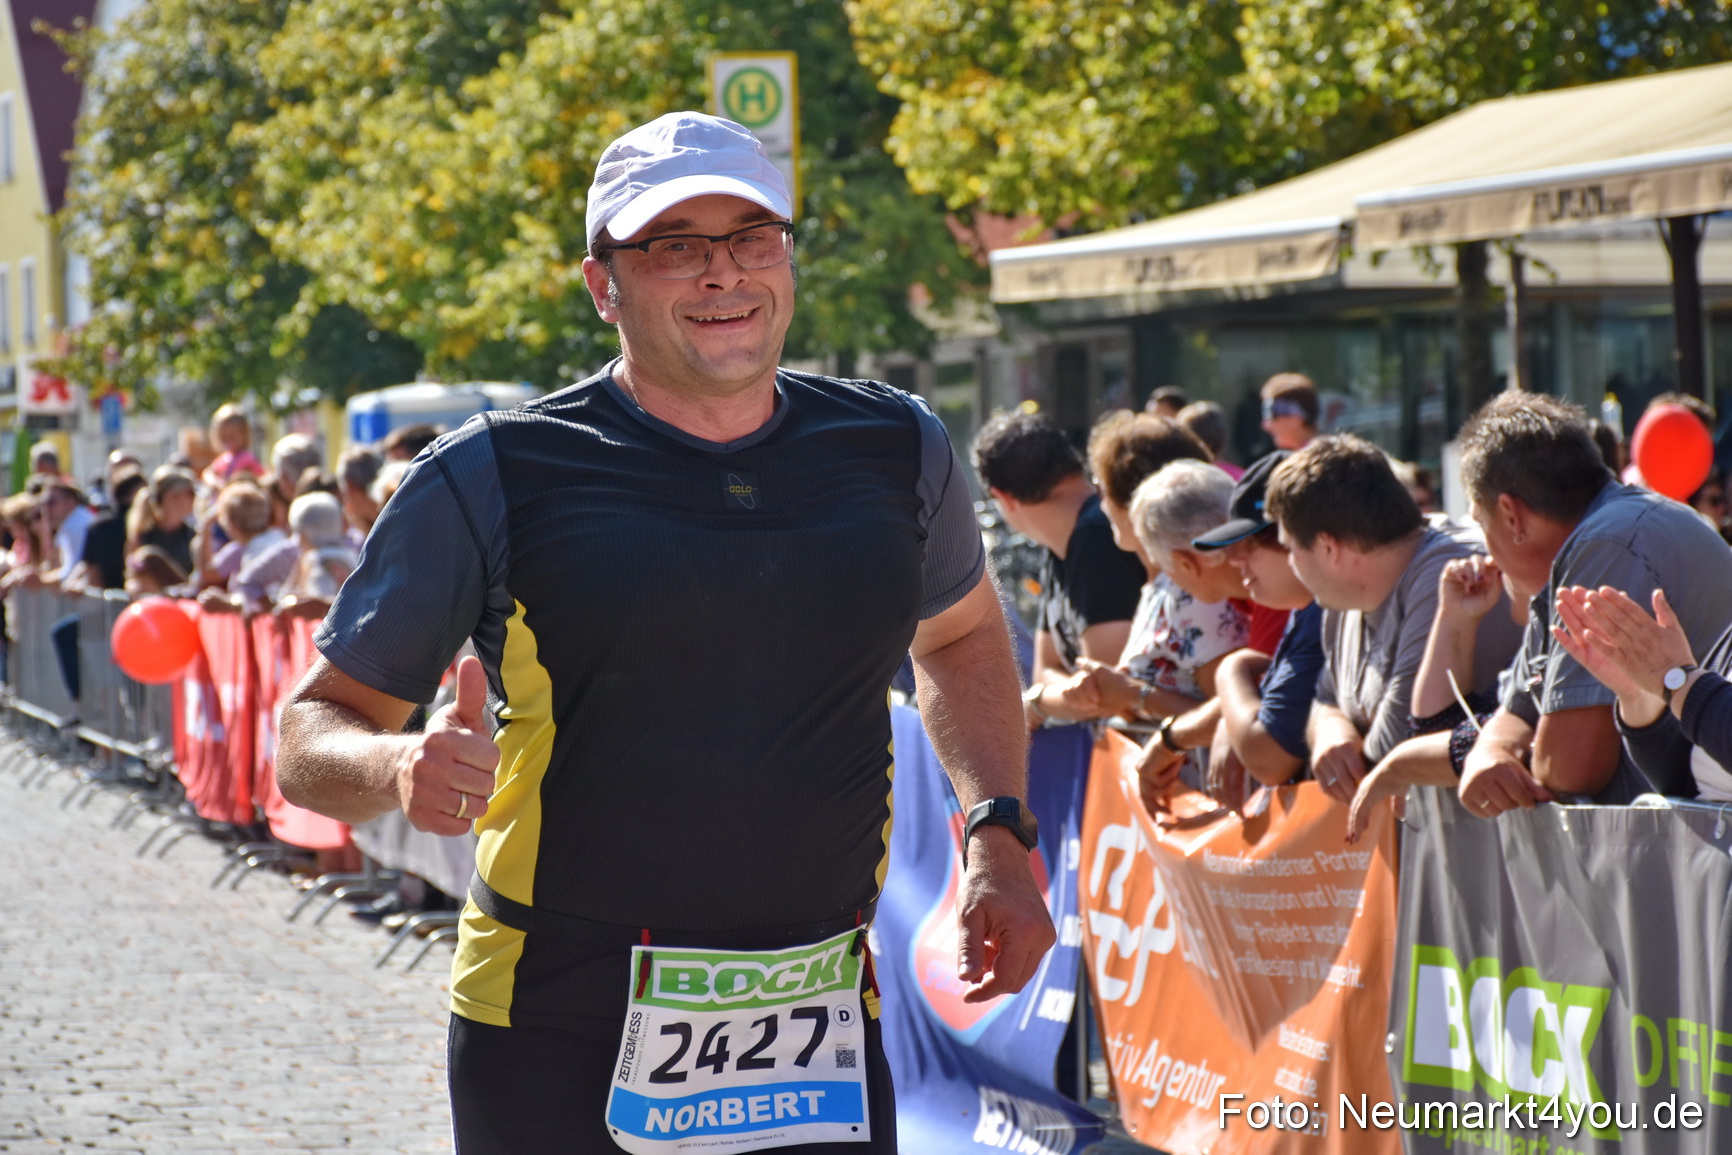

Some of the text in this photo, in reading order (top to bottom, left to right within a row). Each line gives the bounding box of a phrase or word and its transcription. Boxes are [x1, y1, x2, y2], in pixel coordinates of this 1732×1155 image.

[740, 83, 766, 112] H
[729, 485, 752, 493] ODLO
[1315, 850, 1371, 872] Partner
[653, 943, 848, 1003] BOCK
[640, 1012, 651, 1049] ZEITMESSUNG
[839, 1010, 850, 1022] D
[648, 1006, 829, 1084] 2427
[1410, 955, 1605, 1115] BOCK
[644, 1090, 826, 1133] NORBERT
